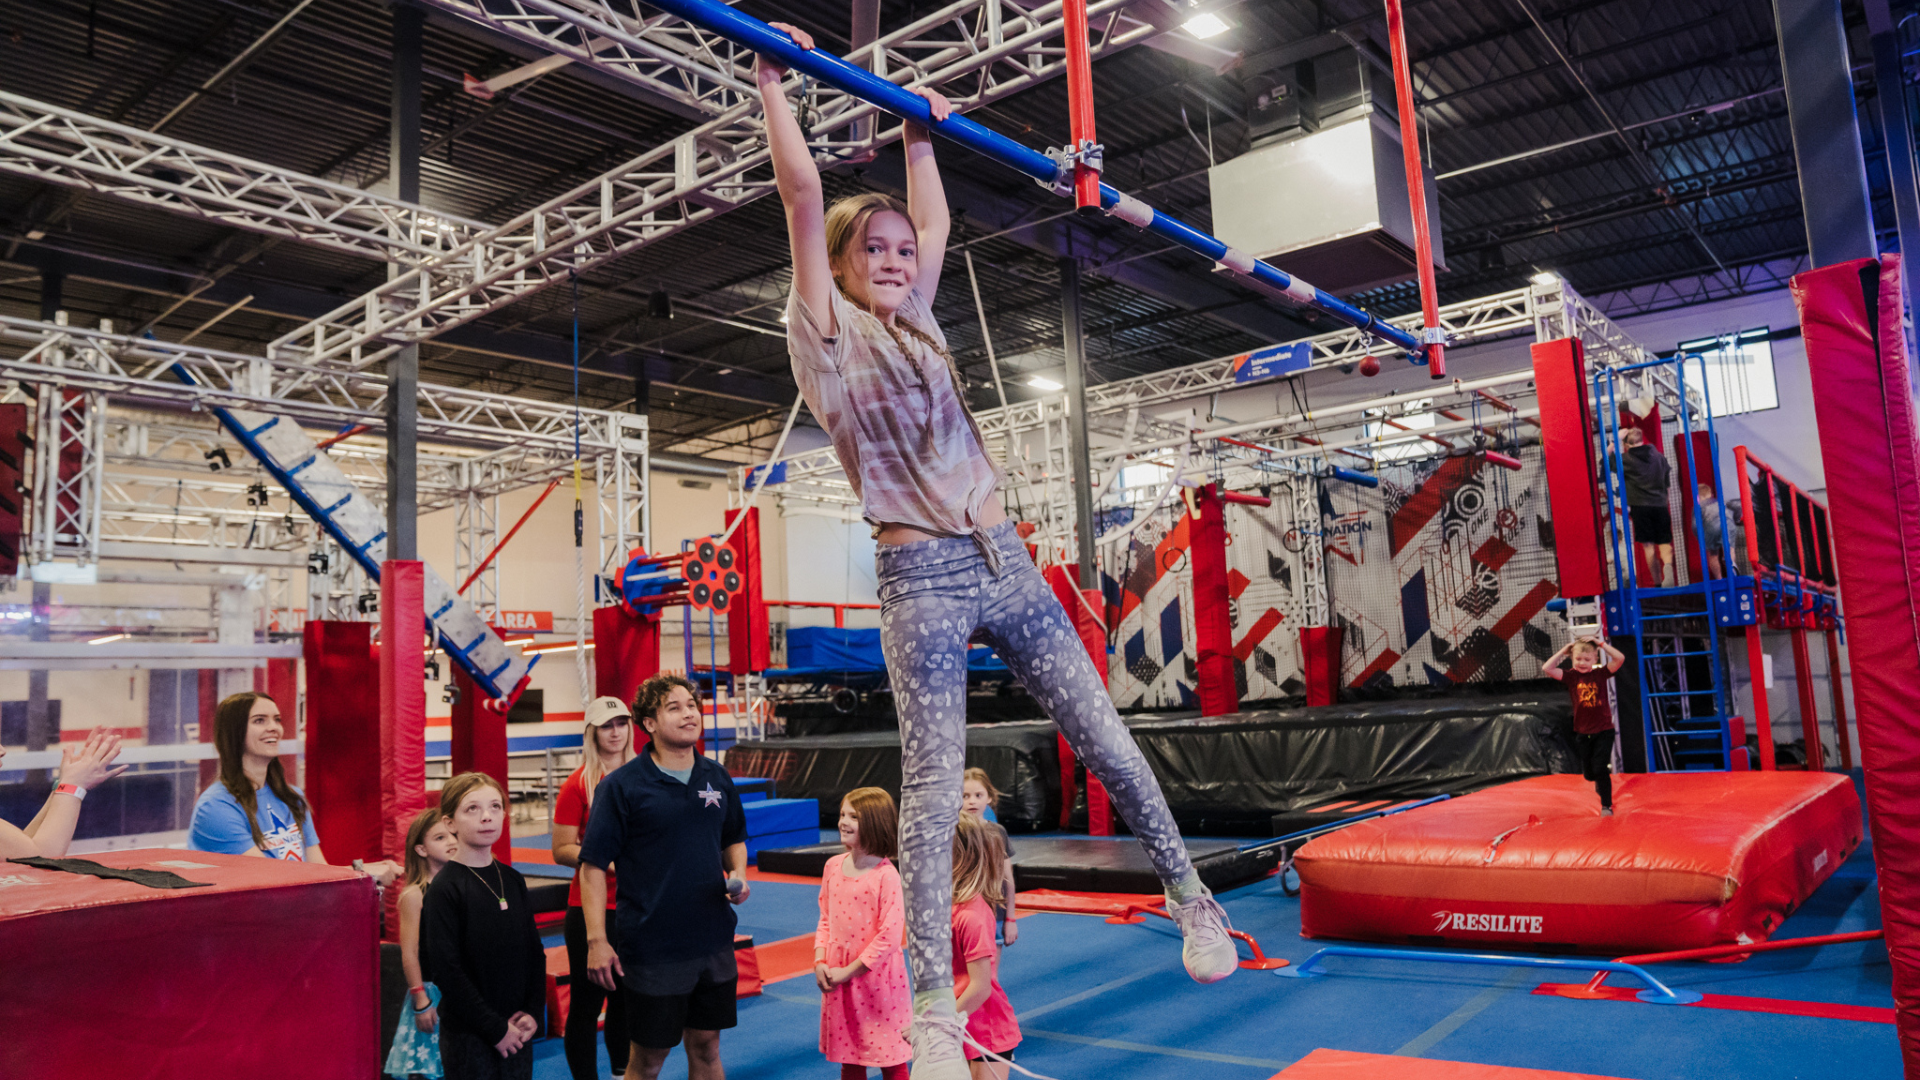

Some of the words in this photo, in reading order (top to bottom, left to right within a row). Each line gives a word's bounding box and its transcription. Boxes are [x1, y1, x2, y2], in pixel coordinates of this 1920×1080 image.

[1251, 352, 1292, 366] Intermediate
[1471, 508, 1489, 535] ONE
[500, 613, 537, 628] AREA
[1452, 912, 1543, 934] RESILITE
